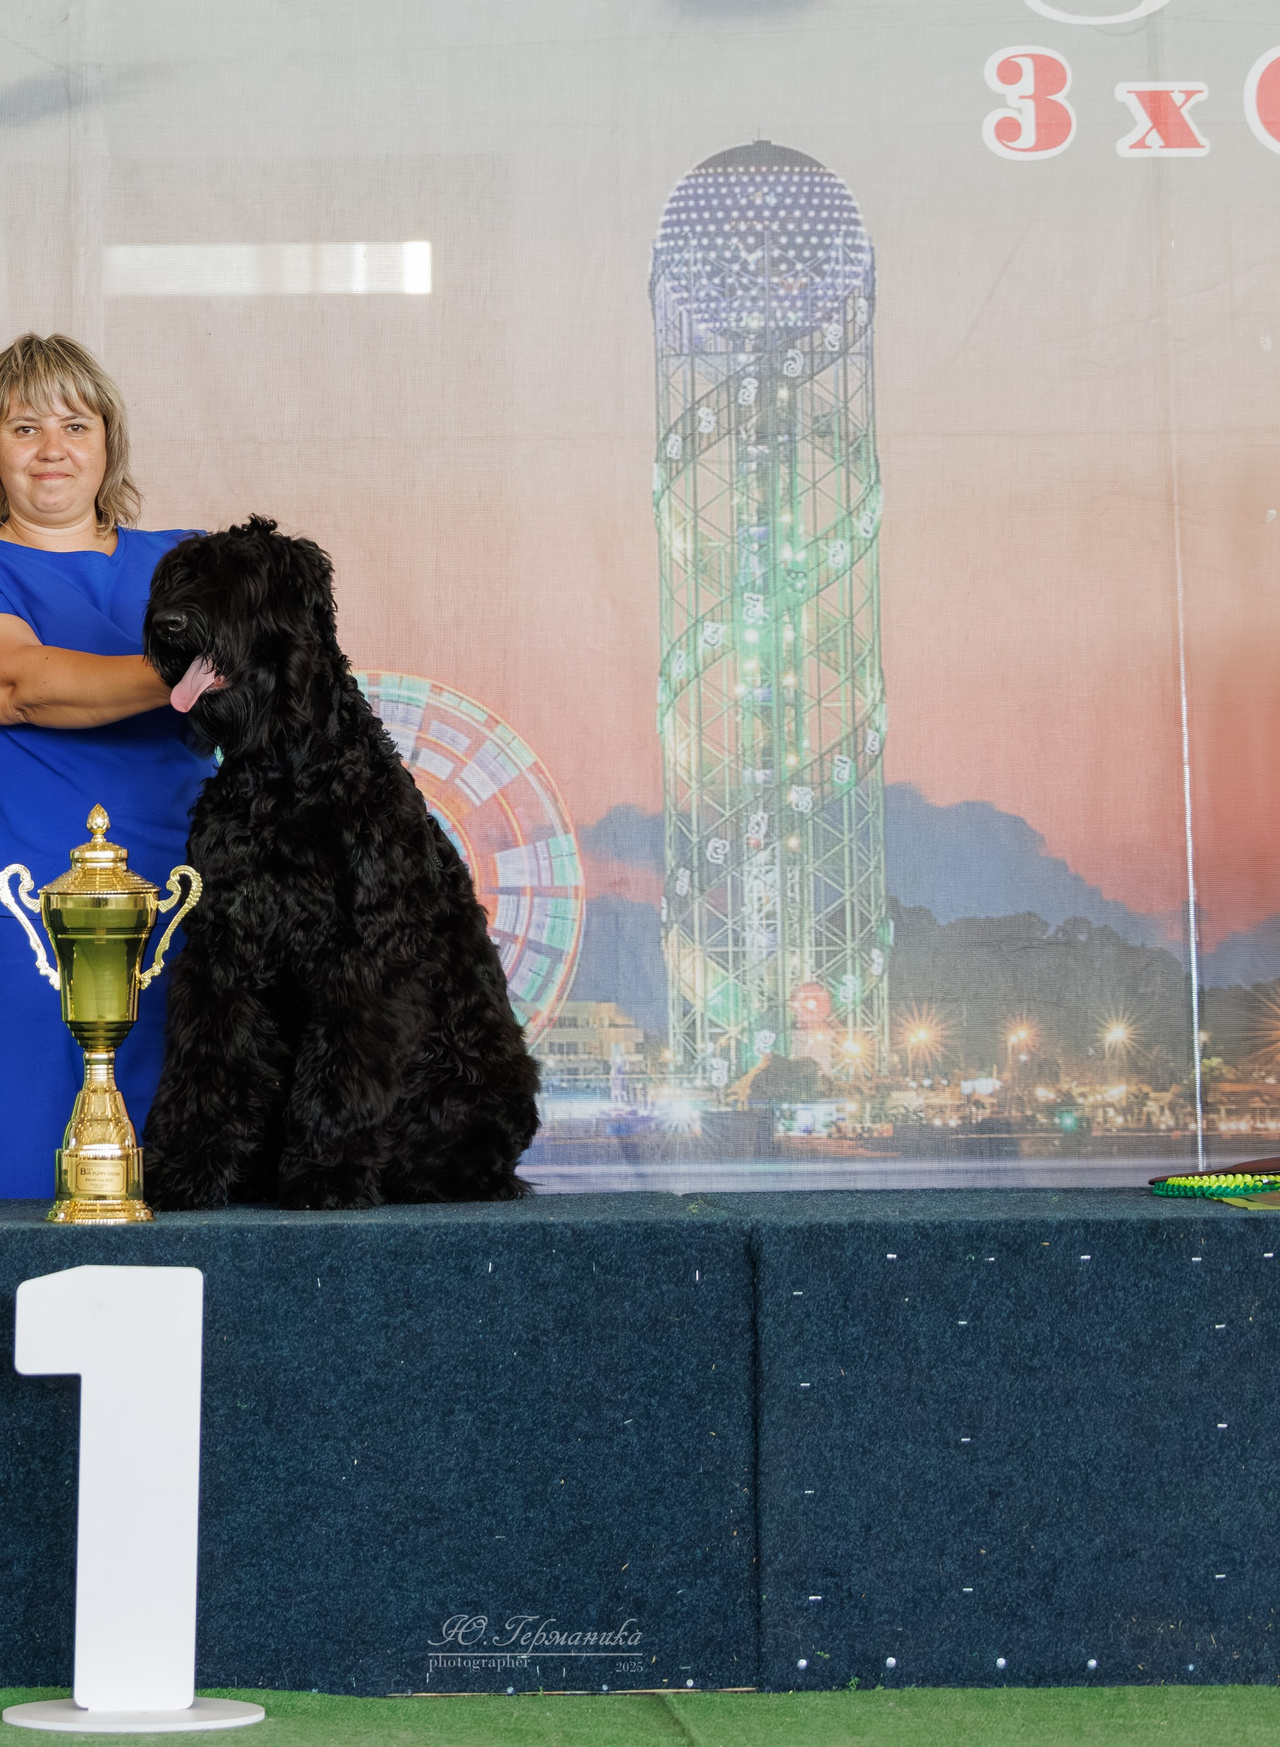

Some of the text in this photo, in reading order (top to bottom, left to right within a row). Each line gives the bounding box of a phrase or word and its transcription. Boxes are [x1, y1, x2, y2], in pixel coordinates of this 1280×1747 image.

[988, 50, 1074, 155] 3
[1121, 87, 1208, 153] x
[15, 1264, 204, 1711] 1
